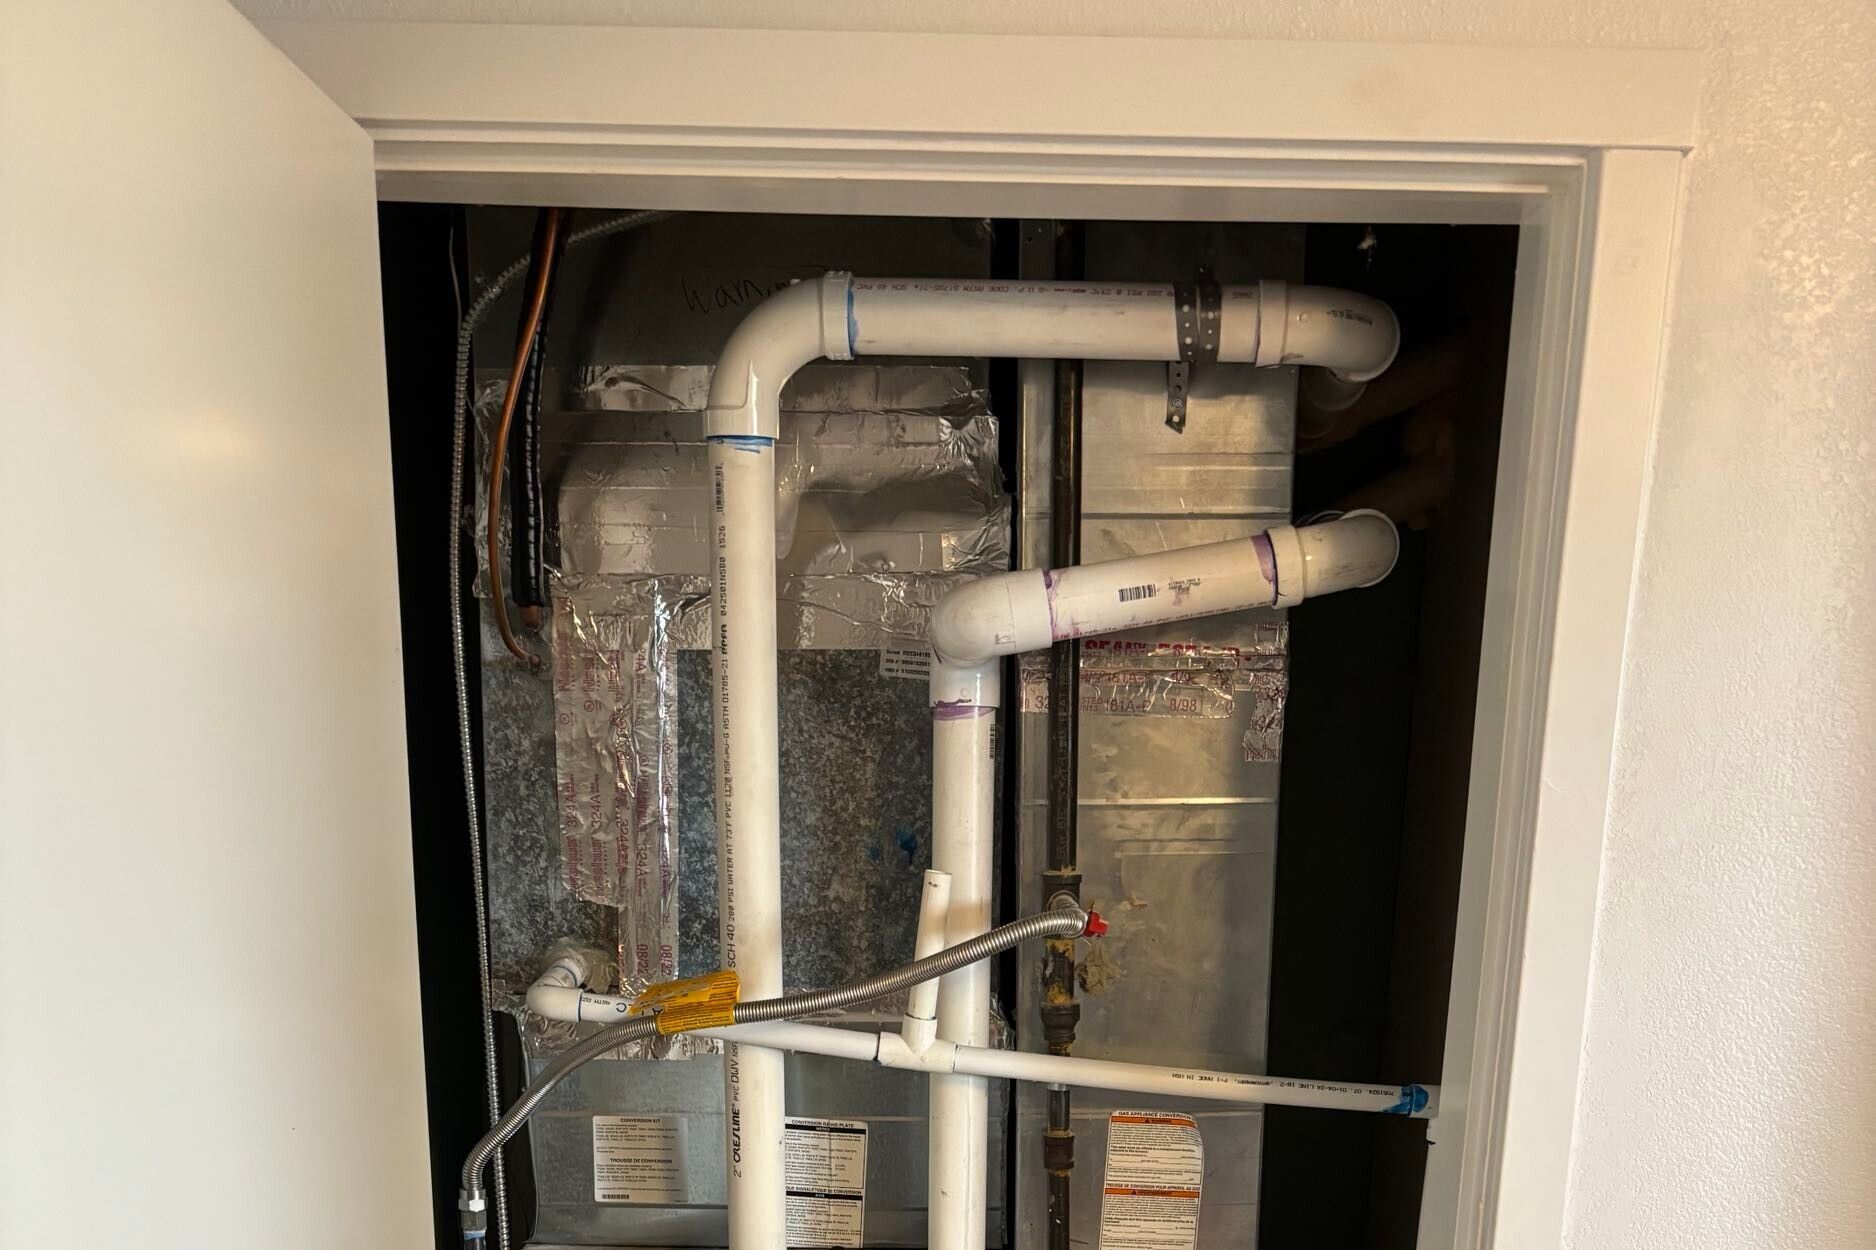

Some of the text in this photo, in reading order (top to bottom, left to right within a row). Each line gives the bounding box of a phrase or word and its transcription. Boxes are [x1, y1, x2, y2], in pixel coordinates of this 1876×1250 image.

[718, 525, 726, 548] 1526
[1169, 698, 1197, 712] 8/98
[722, 706, 730, 730] ASTM
[724, 776, 732, 798] 1120
[591, 794, 602, 828] 324A
[724, 801, 732, 818] PVC
[726, 844, 733, 854] AT
[726, 857, 734, 885] WATER
[726, 924, 736, 940] 40
[728, 943, 736, 968] SCH
[730, 1060, 739, 1084] DWV
[732, 1086, 740, 1102] PVC
